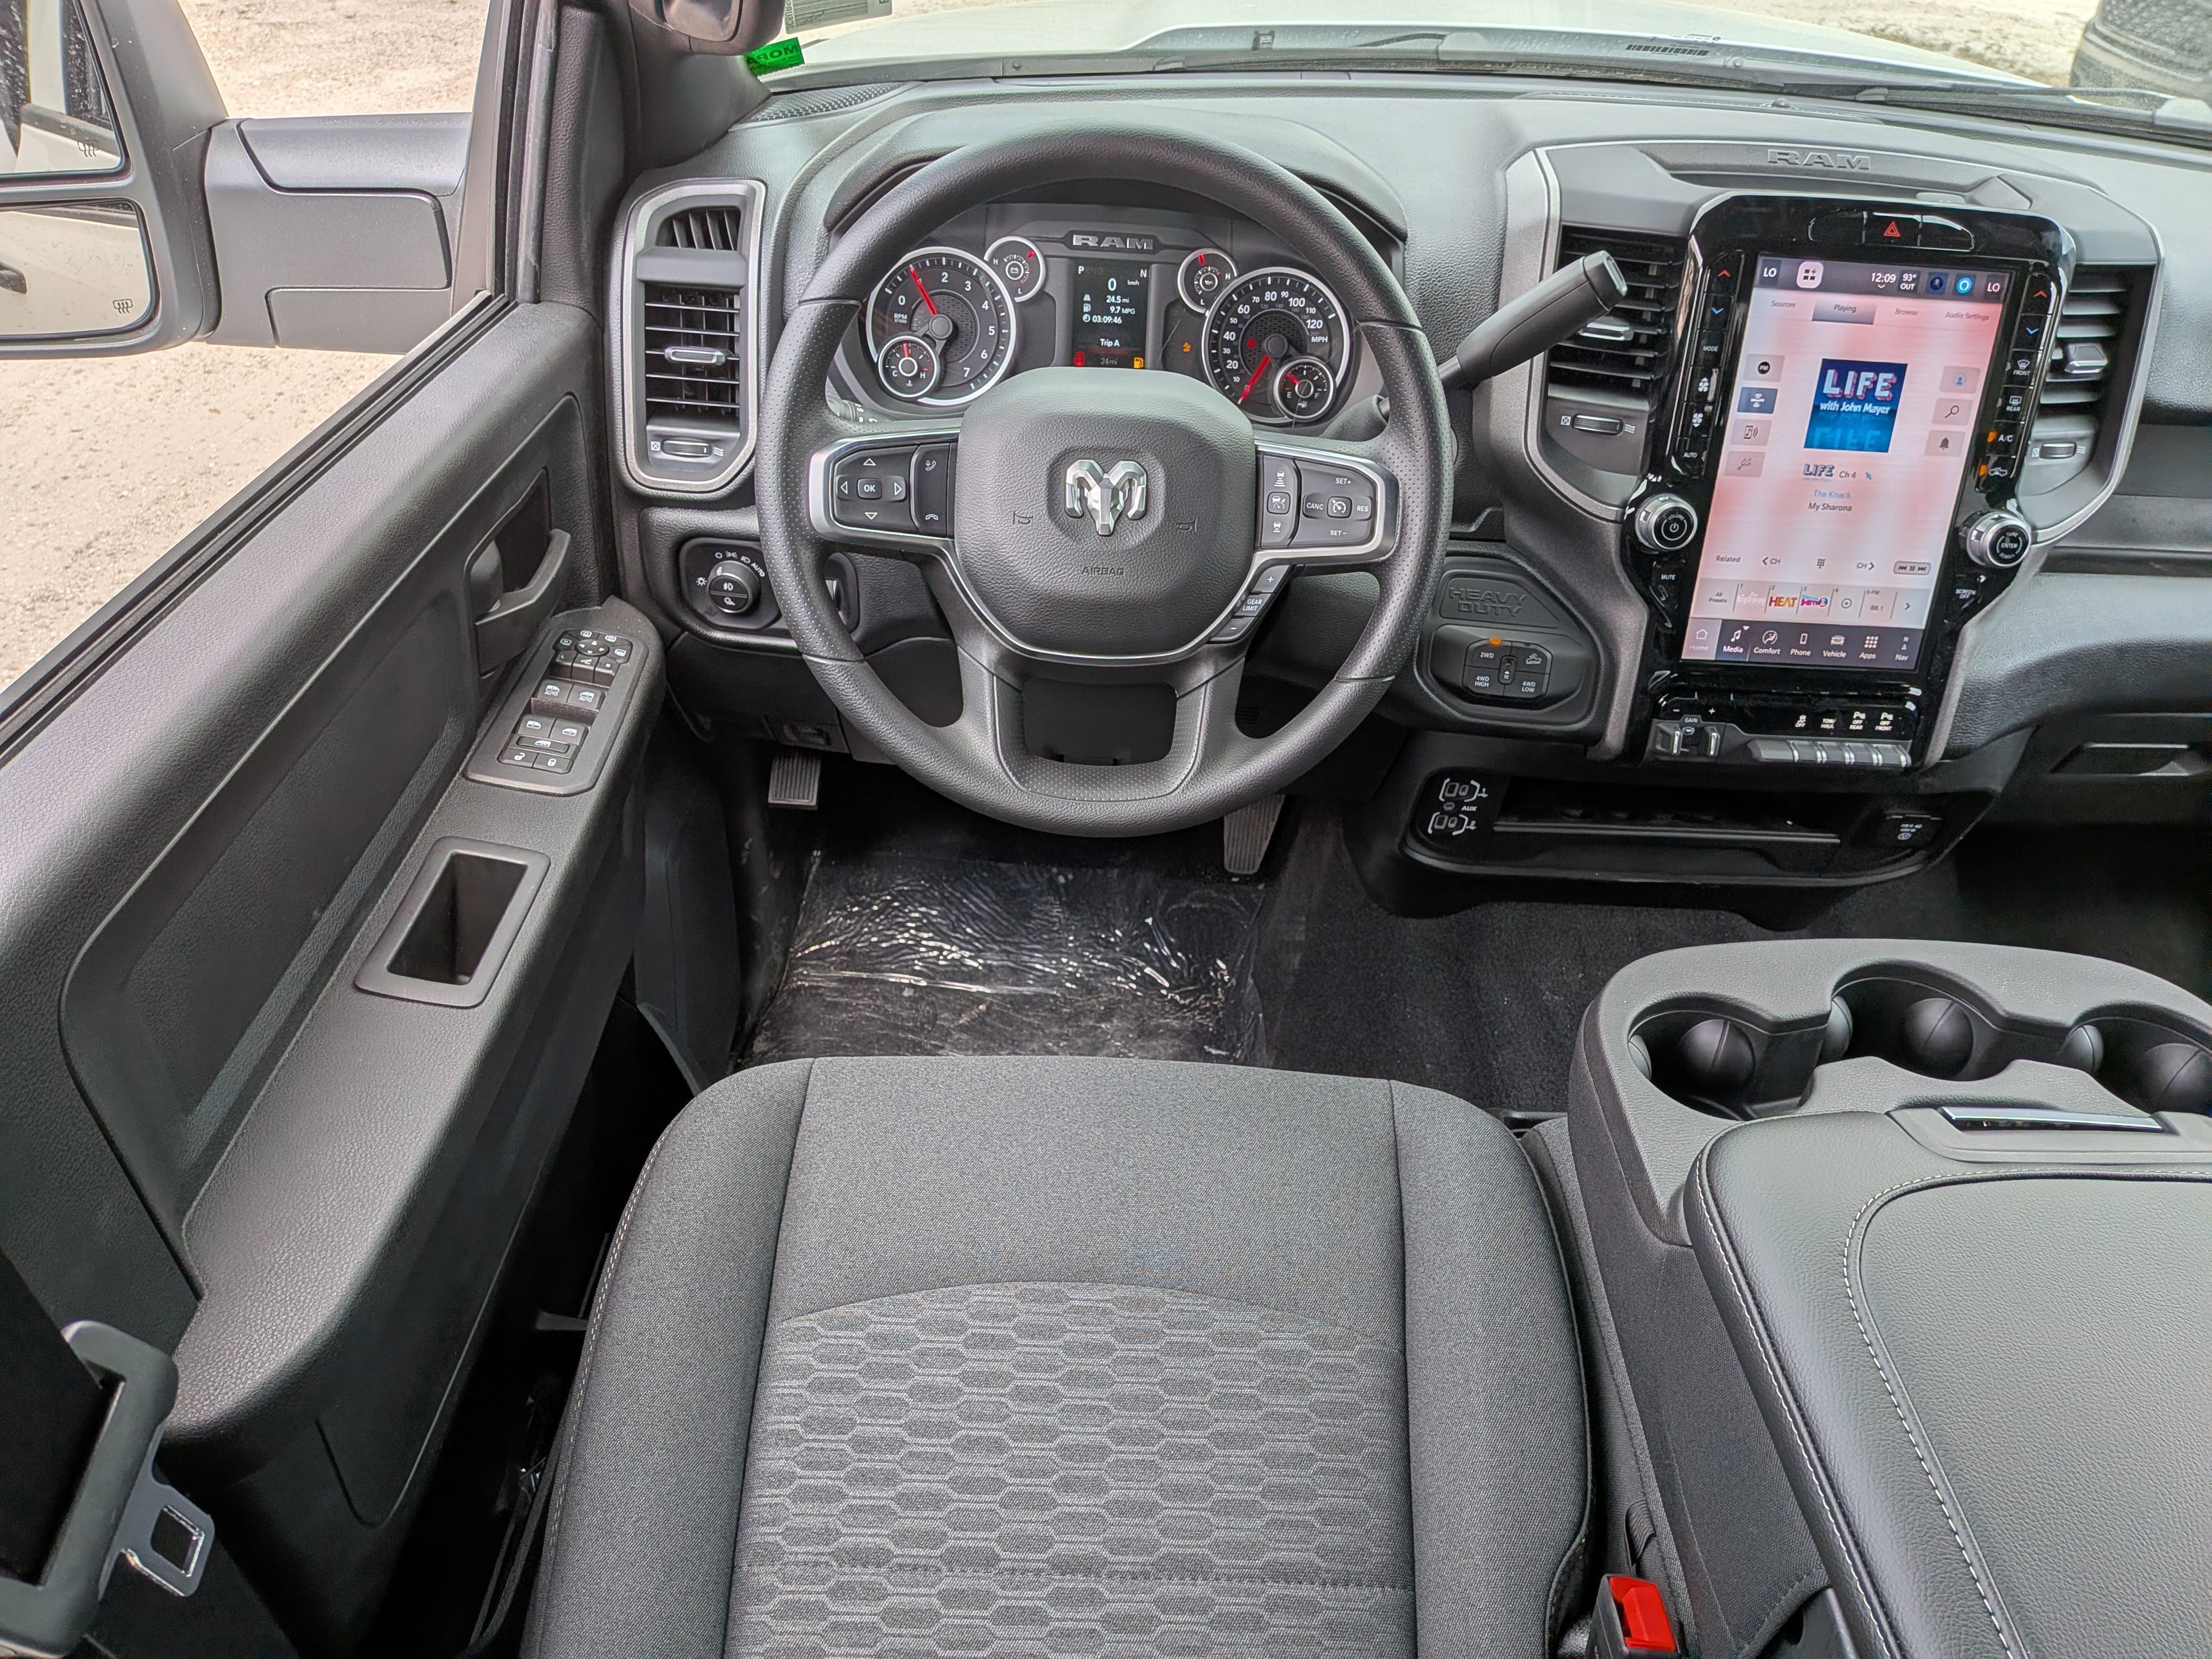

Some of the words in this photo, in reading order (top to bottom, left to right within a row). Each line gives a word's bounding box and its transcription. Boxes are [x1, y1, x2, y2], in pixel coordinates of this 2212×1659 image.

[1767, 148, 1870, 170] RAM
[1073, 234, 1153, 250] RAM
[941, 272, 948, 283] 2
[1140, 269, 1147, 278] N
[1763, 268, 1777, 277] LO
[1871, 273, 1896, 283] 12:09
[964, 281, 972, 291] 3
[1108, 278, 1117, 291] 0
[1987, 282, 2000, 292] LO
[899, 296, 906, 305] 0
[1106, 295, 1121, 304] 24.5
[1264, 291, 1277, 301] 80
[982, 301, 989, 310] 4
[1288, 298, 1306, 307] 100
[1238, 305, 1250, 314] 60
[1833, 304, 1856, 314] Playing
[1895, 308, 1918, 316] Browse
[1092, 315, 1122, 324] 03:09:46
[1964, 313, 1990, 321] Settings
[1306, 319, 1323, 329] 120
[988, 326, 995, 336] 5
[1223, 331, 1236, 341] 40
[1100, 338, 1113, 347] Trip
[980, 349, 988, 359] 6
[1226, 359, 1239, 369] 20
[964, 368, 971, 377] 7
[1823, 369, 1898, 401] LIFE
[1819, 400, 1839, 411] with
[1840, 401, 1861, 413] John
[1863, 403, 1891, 415] Mayer
[1803, 464, 1835, 477] LIFE
[1307, 502, 1324, 510] CANC
[1808, 502, 1820, 512] My
[1820, 503, 1853, 512] Sharona
[751, 562, 765, 577] AUTO
[1081, 566, 1125, 576] AIRBAG
[1449, 587, 1528, 605] HEAVY
[1768, 596, 1797, 608] HEAT
[1458, 600, 1523, 617] DUTY
